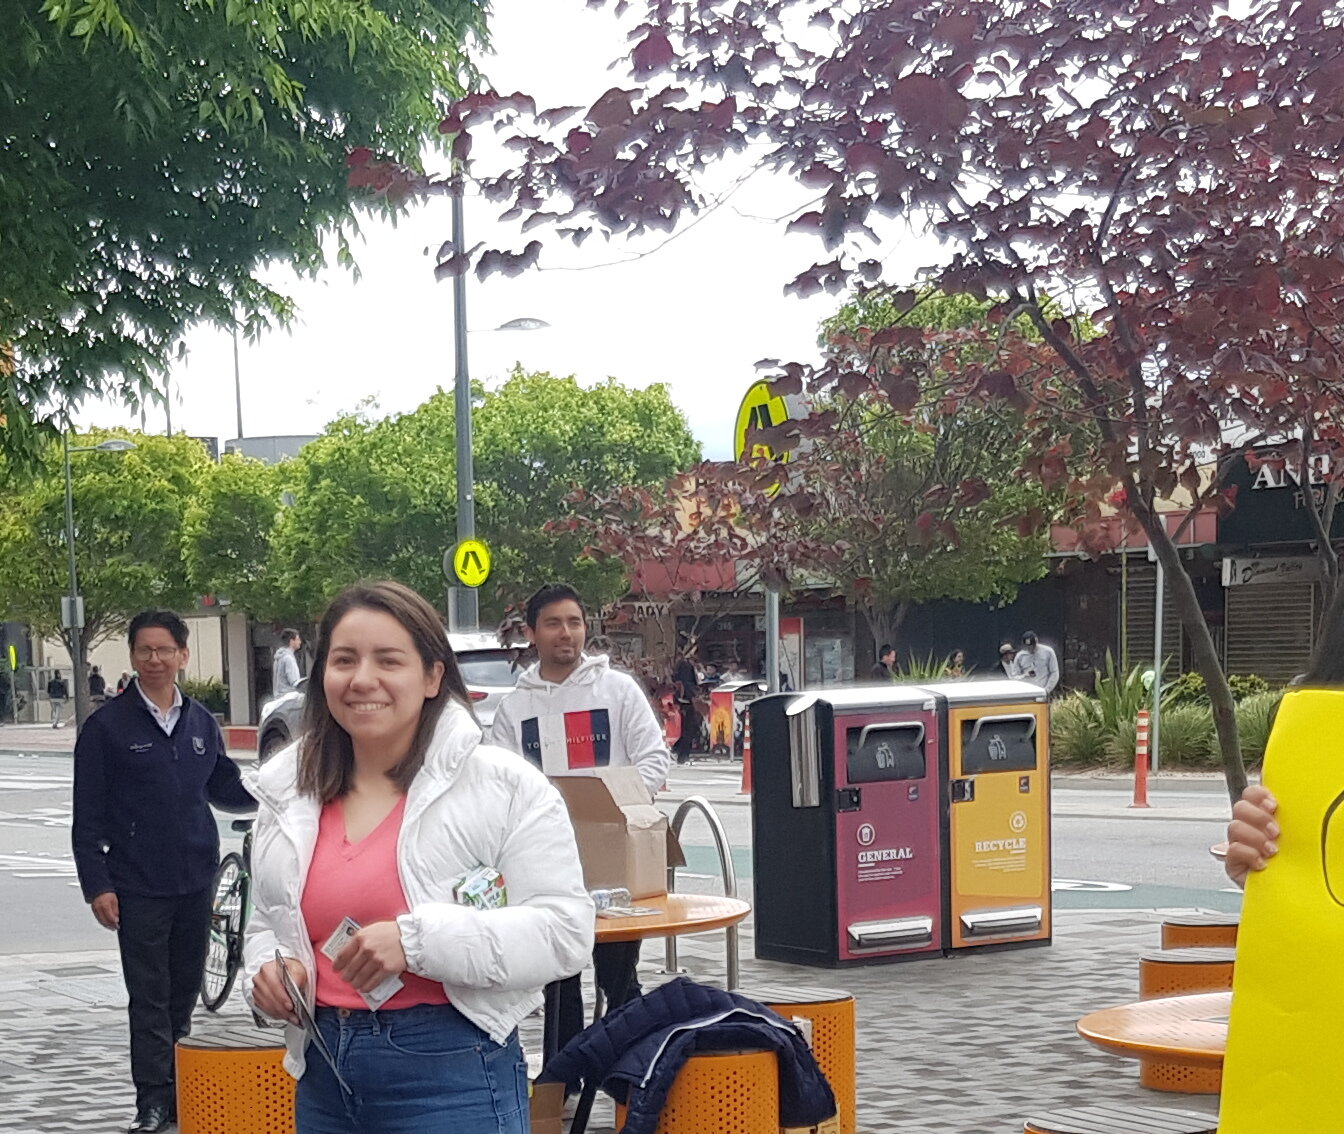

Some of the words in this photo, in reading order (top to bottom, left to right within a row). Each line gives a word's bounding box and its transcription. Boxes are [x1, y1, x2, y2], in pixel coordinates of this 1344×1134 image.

[566, 733, 608, 745] HILFIGER
[975, 837, 1027, 853] RECYCLE
[858, 847, 913, 863] GENERAL
